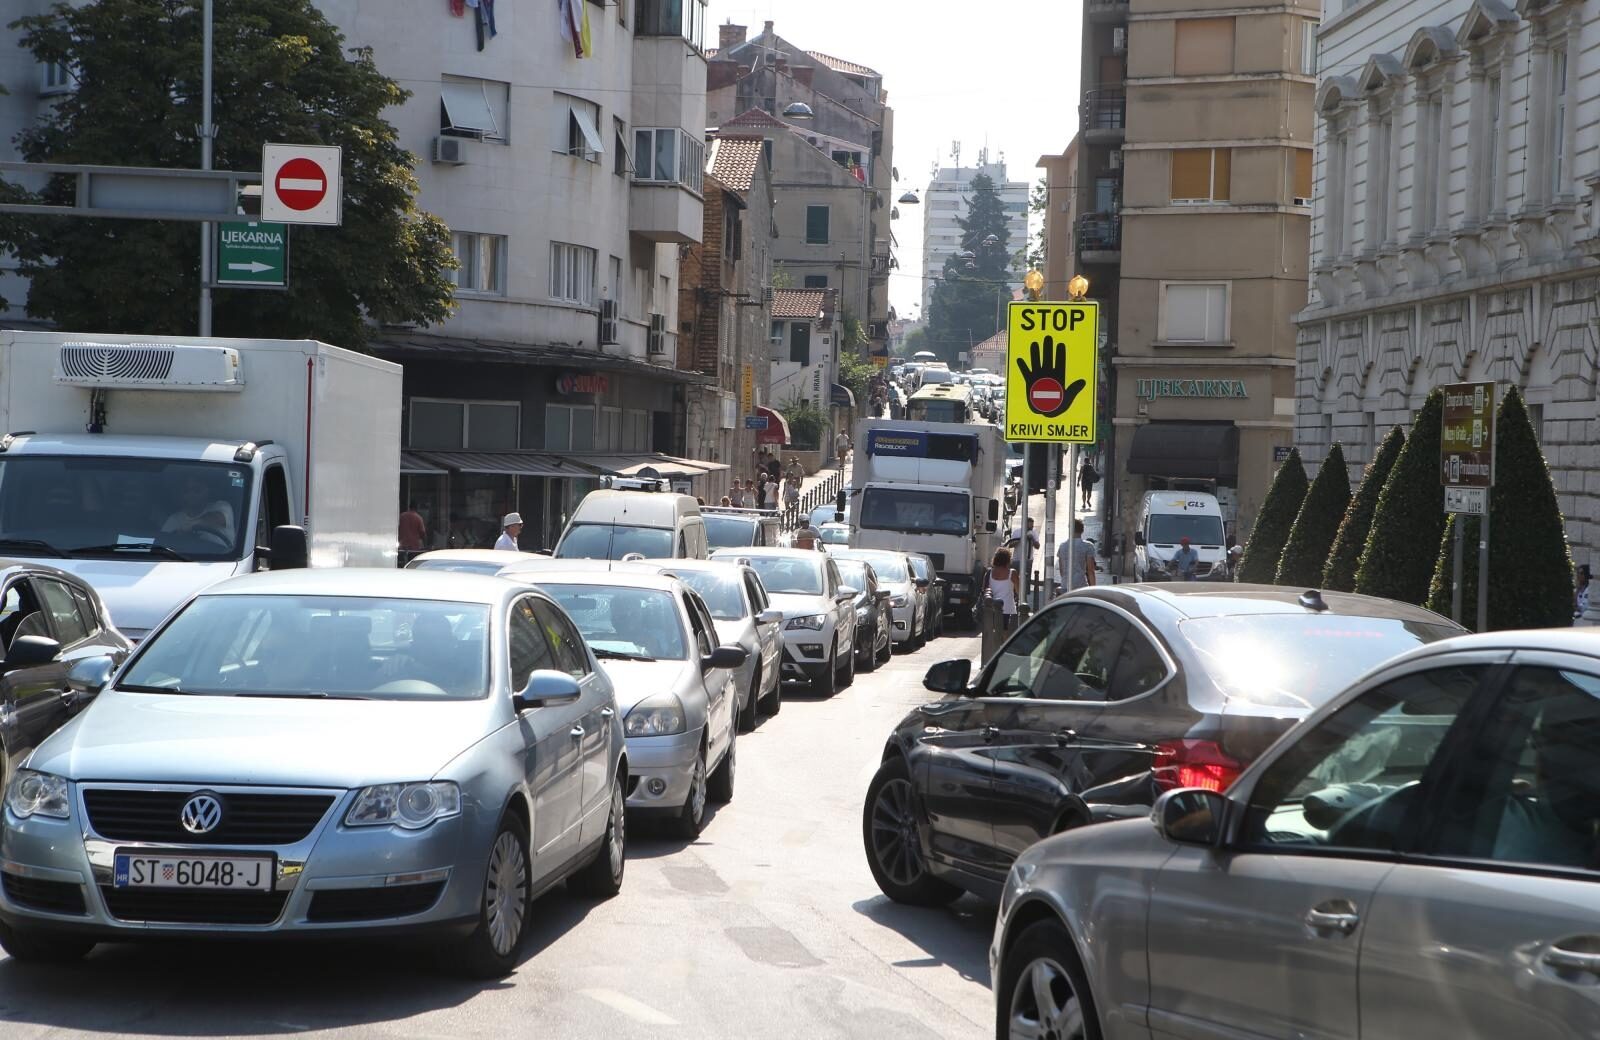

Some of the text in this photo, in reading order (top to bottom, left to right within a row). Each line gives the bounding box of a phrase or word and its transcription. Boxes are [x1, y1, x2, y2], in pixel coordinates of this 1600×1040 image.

[221, 230, 283, 244] LJEKARNA
[1020, 308, 1085, 331] STOP
[1136, 379, 1248, 401] LJEKARNA
[1010, 423, 1089, 437] KRIVI SMJER
[1187, 500, 1206, 508] GLS
[181, 795, 222, 834] VW
[116, 873, 128, 881] HR
[132, 859, 261, 887] ST 6048-J
